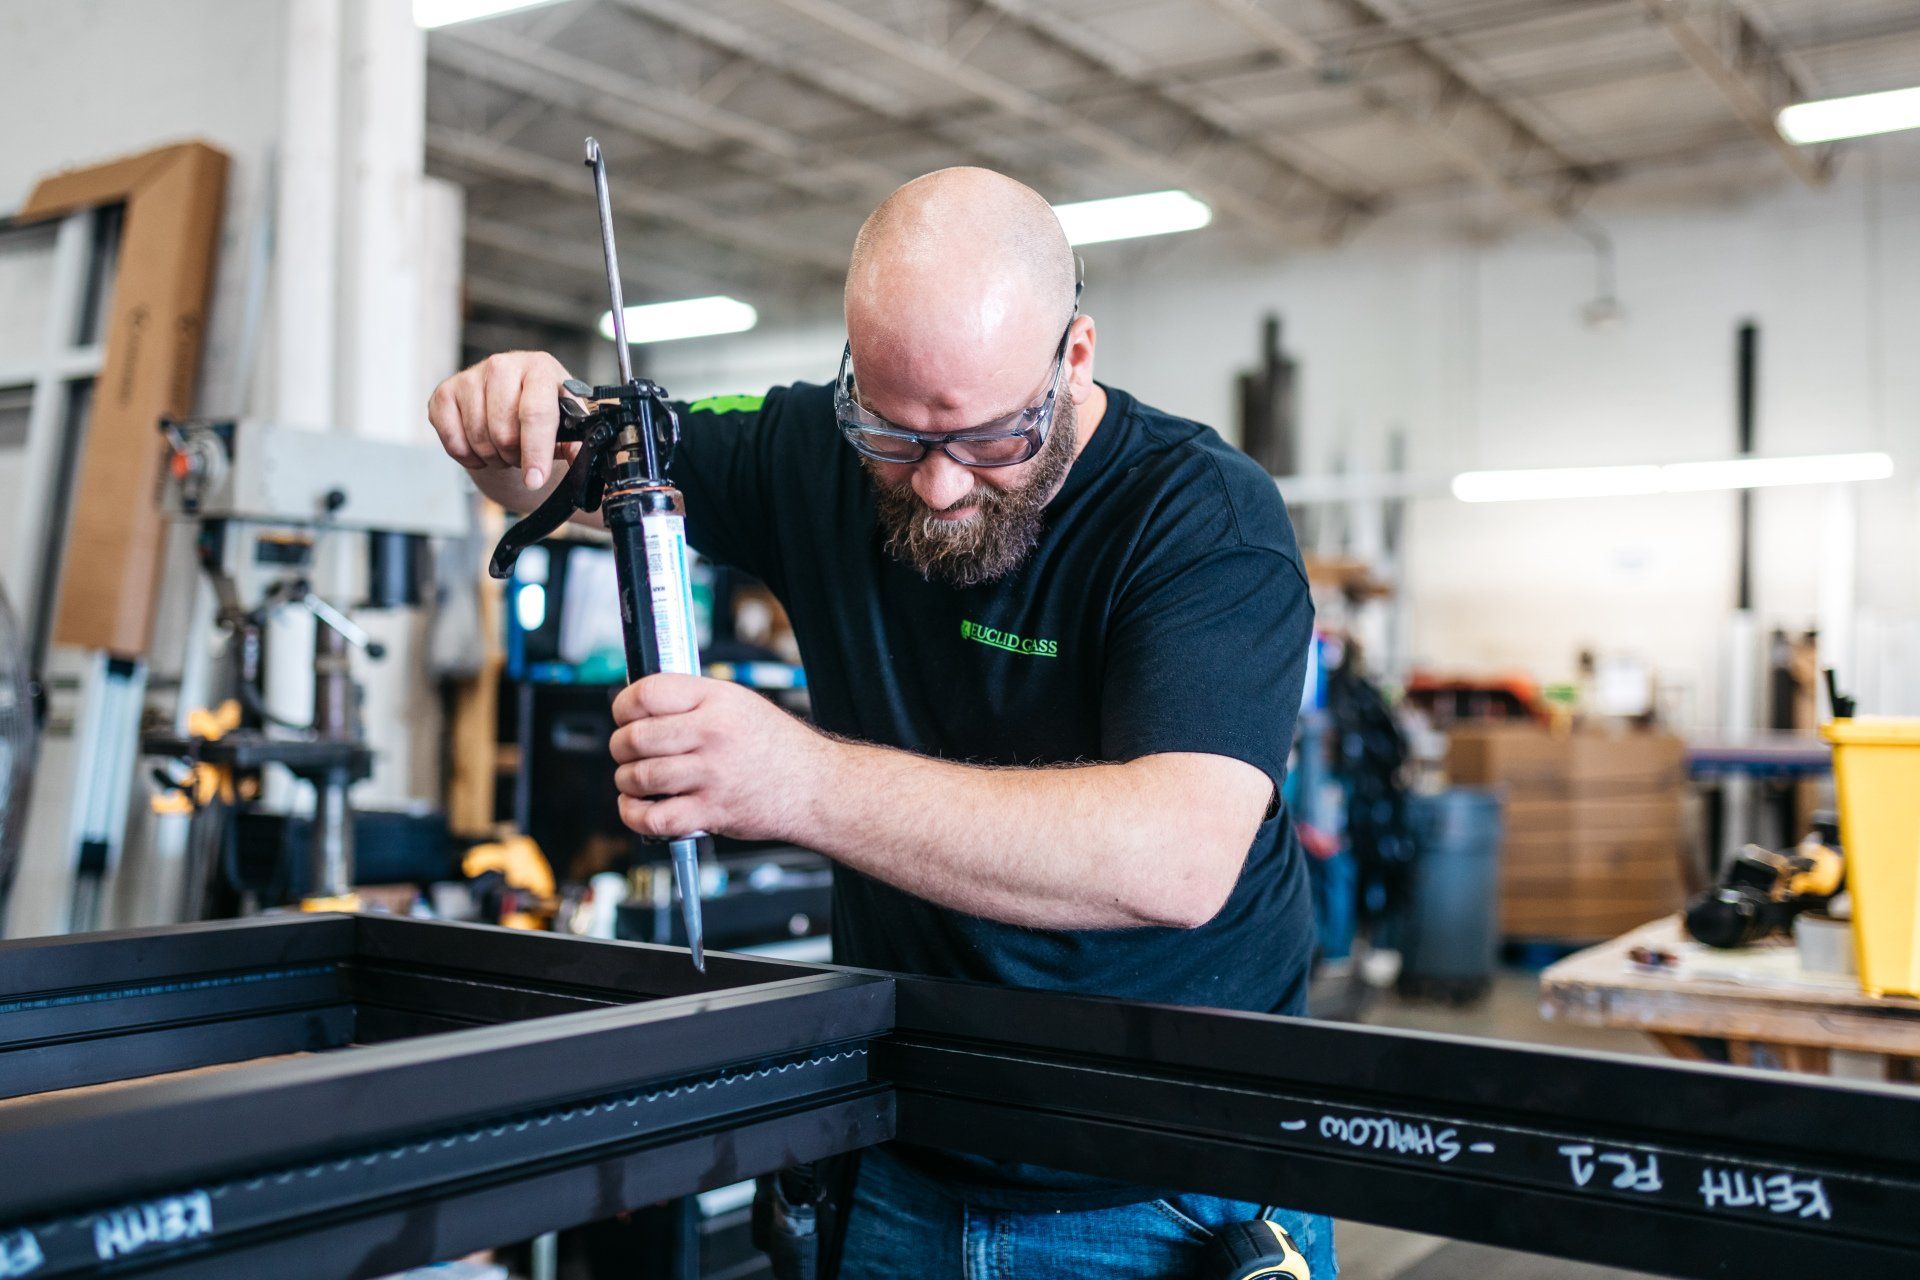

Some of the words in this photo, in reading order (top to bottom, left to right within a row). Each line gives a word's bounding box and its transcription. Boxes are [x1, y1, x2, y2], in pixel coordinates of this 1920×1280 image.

[971, 623, 1019, 648] EUCLID
[1022, 639, 1058, 653] GASS
[1320, 1115, 1462, 1163] SHALLOW
[1699, 1168, 1831, 1219] KEITH
[95, 1189, 213, 1260] KEITH
